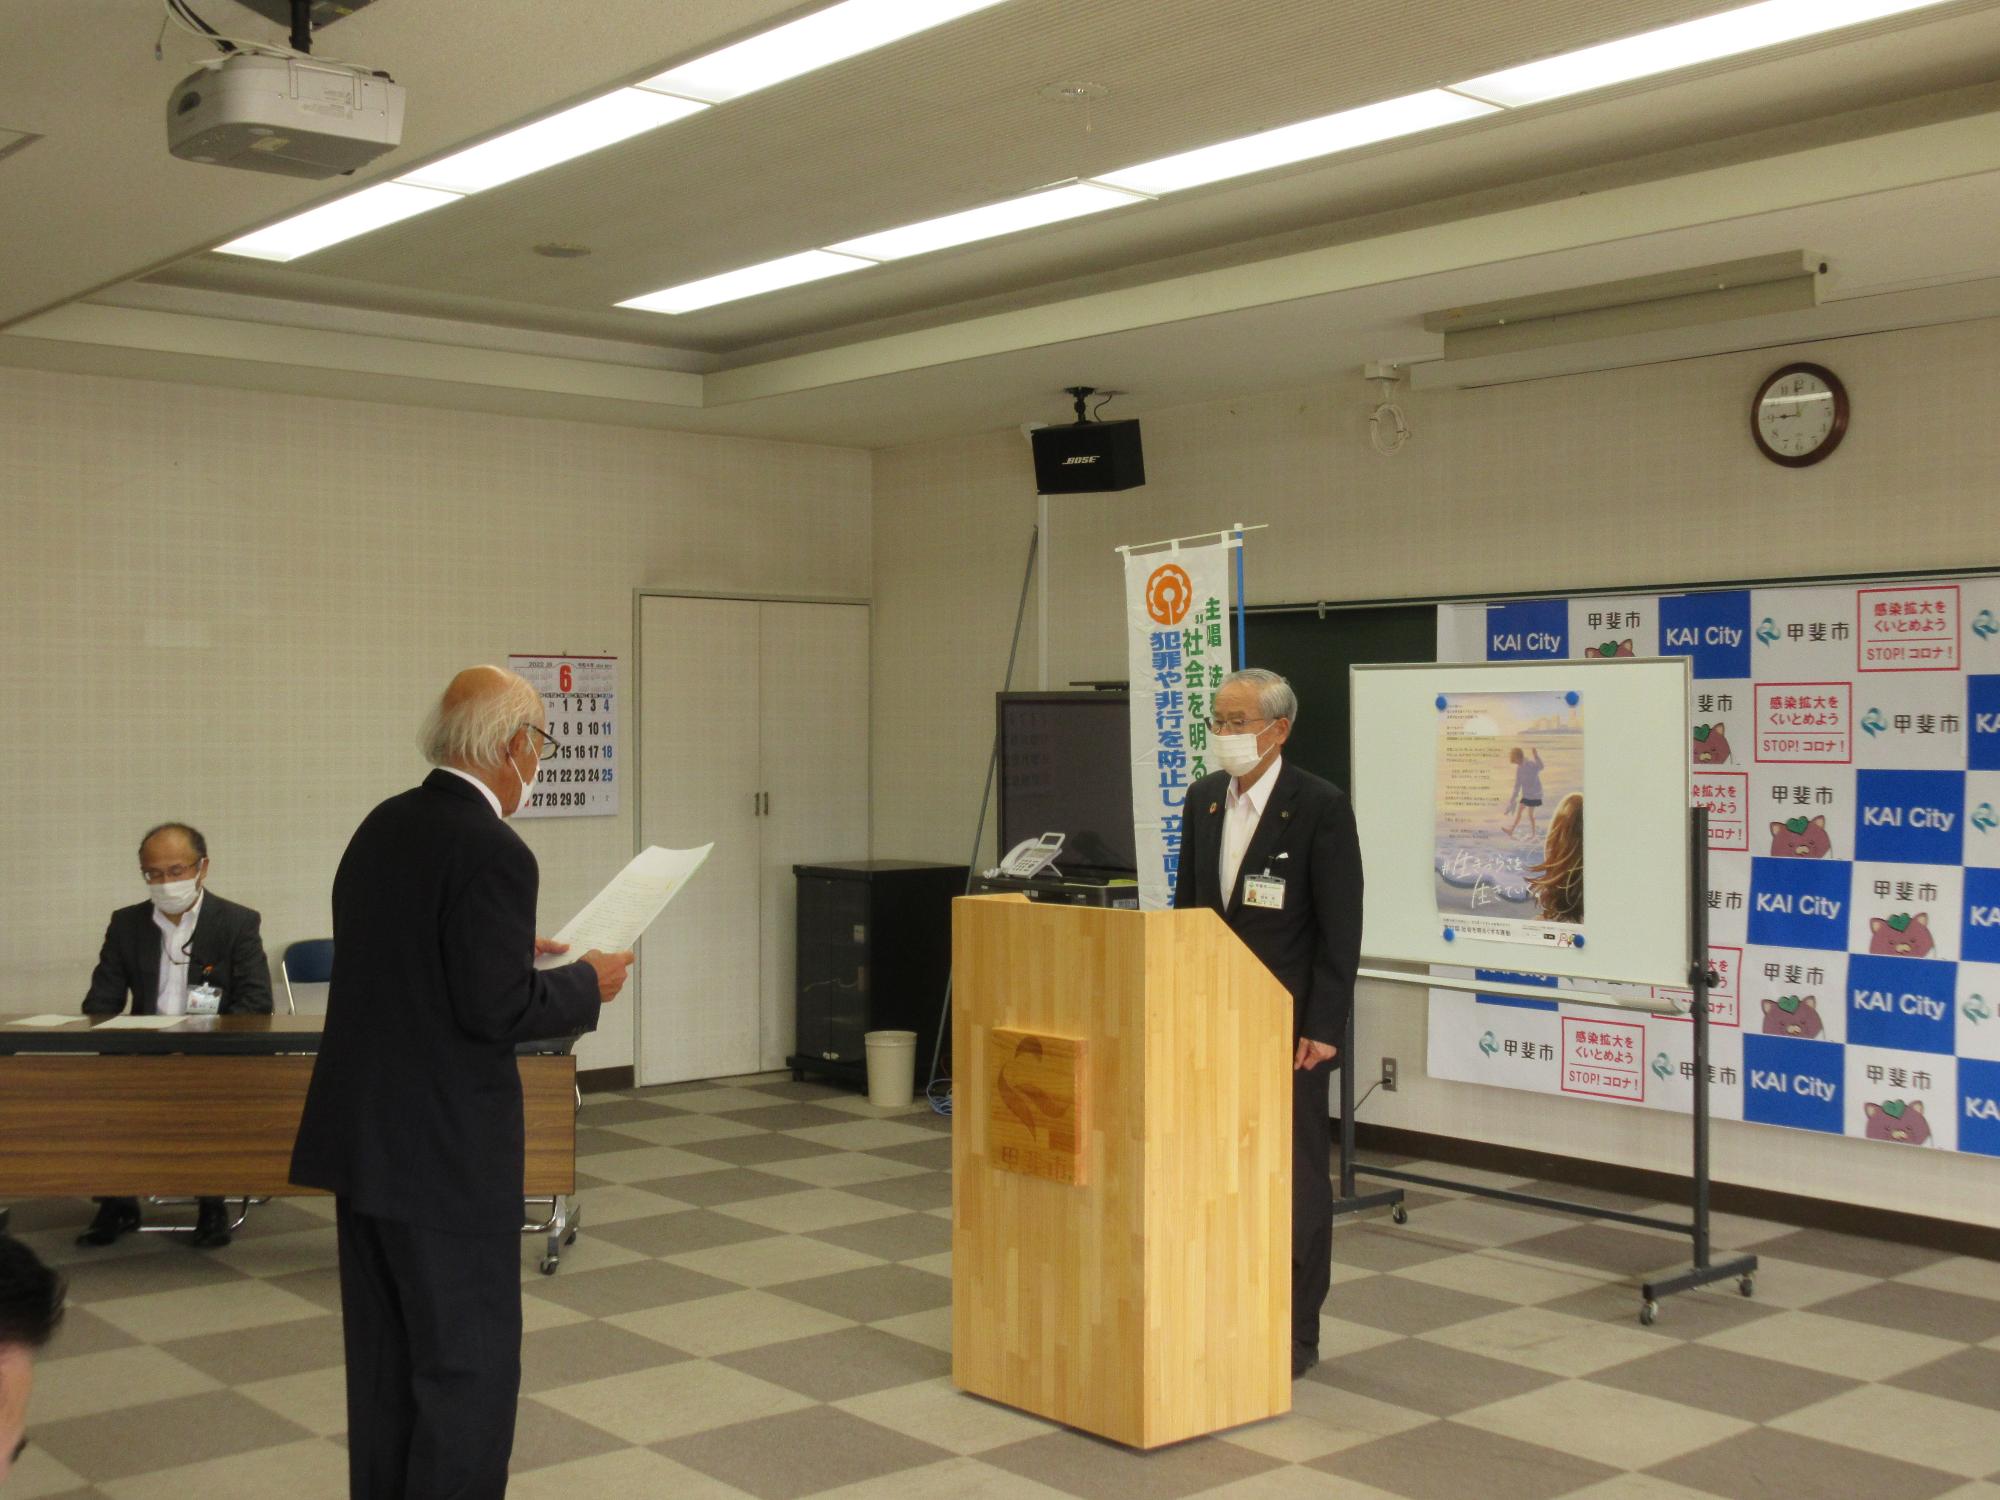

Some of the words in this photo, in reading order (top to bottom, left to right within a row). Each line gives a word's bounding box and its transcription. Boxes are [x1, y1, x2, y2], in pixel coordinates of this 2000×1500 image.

[1061, 455, 1101, 465] BOSE
[1874, 601, 1946, 617] 感染拡大を
[1588, 610, 1641, 630] 甲斐市
[1874, 618, 1946, 633] くいとめよう
[1665, 627, 1699, 647] KAI
[1705, 626, 1743, 648] City
[1787, 622, 1849, 642] 甲斐市
[1493, 634, 1522, 652] KAI
[1526, 633, 1562, 653] City
[1867, 648, 1905, 661] STOP!
[560, 664, 572, 692] 6
[563, 699, 568, 712] 1
[577, 699, 583, 712] 2
[590, 699, 597, 712] 3
[603, 699, 610, 712] 4
[1698, 694, 1733, 713] 斐市
[1770, 695, 1839, 710] 感染拡大を
[563, 722, 569, 735] 8
[577, 722, 583, 735] 9
[588, 722, 599, 735] 10
[602, 722, 612, 735] 11
[1150, 630, 1188, 807] 犯罪や非行を防止し
[1770, 712, 1839, 726] くいとめよう
[1894, 713, 1960, 734] 甲斐市
[561, 745, 572, 759] 15
[575, 745, 586, 759] 16
[588, 745, 599, 759] 17
[602, 745, 612, 759] 18
[1763, 740, 1800, 753] STOP!
[546, 769, 557, 782] 21
[560, 769, 572, 782] 22
[574, 769, 586, 782] 23
[588, 769, 600, 782] 24
[602, 768, 613, 782] 25
[532, 794, 543, 807] 27
[546, 793, 558, 807] 28
[560, 793, 571, 807] 29
[574, 793, 586, 806] 30
[1692, 784, 1737, 799] 染拡大を
[1772, 785, 1833, 805] 甲斐市
[1863, 806, 1902, 827] KAI
[1909, 807, 1955, 832] City
[1706, 890, 1743, 910] 斐市
[1873, 880, 1938, 902] 甲斐市
[1756, 892, 1793, 914] KAI
[1800, 895, 1841, 920] City
[1970, 906, 2000, 927] KA
[1764, 963, 1824, 985] 甲斐市
[1854, 989, 1892, 1012] KAI
[1900, 994, 1946, 1021] City
[1575, 1030, 1634, 1048] 感染拡大を
[1504, 1039, 1554, 1062] 甲斐市
[1575, 1046, 1634, 1064] くいとめよう
[1569, 1070, 1600, 1086] STOP!
[1751, 1069, 1787, 1093] KAI
[1793, 1074, 1836, 1102] City
[1866, 1064, 1932, 1090] 甲斐市
[1965, 1095, 2000, 1121] KA
